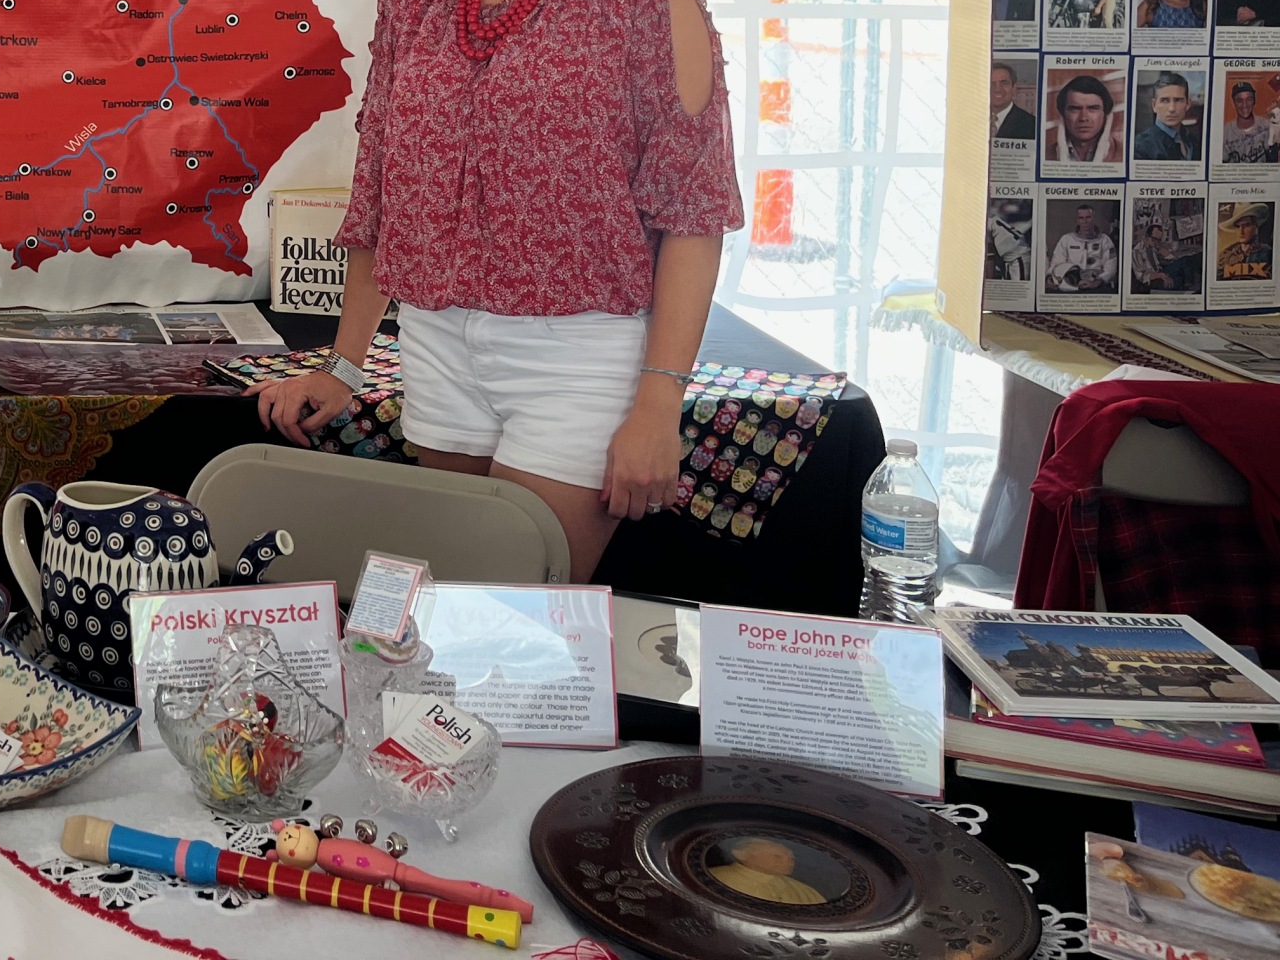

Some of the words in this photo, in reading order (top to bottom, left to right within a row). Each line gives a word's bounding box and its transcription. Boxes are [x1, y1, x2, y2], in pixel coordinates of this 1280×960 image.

[195, 24, 225, 34] Lublin
[1056, 56, 1086, 65] Robert
[1092, 56, 1115, 65] Urich
[1224, 59, 1256, 68] GEORGE
[64, 121, 98, 154] Wisla
[994, 140, 1028, 150] Sestak
[995, 186, 1030, 196] KOSAR
[1045, 188, 1079, 196] EUGENE
[1084, 188, 1118, 196] CERNAN
[1139, 188, 1164, 196] STEVE
[1170, 188, 1196, 196] DITKO
[280, 261, 344, 285] ziemi
[1224, 262, 1270, 278] MIX
[151, 607, 217, 633] Polski
[224, 602, 320, 628] Kryształ
[739, 623, 787, 641] Pope
[793, 630, 835, 646] John
[747, 640, 777, 651] born:
[781, 646, 812, 656] Karol
[814, 650, 844, 659] Józef
[425, 704, 472, 745] Polish
